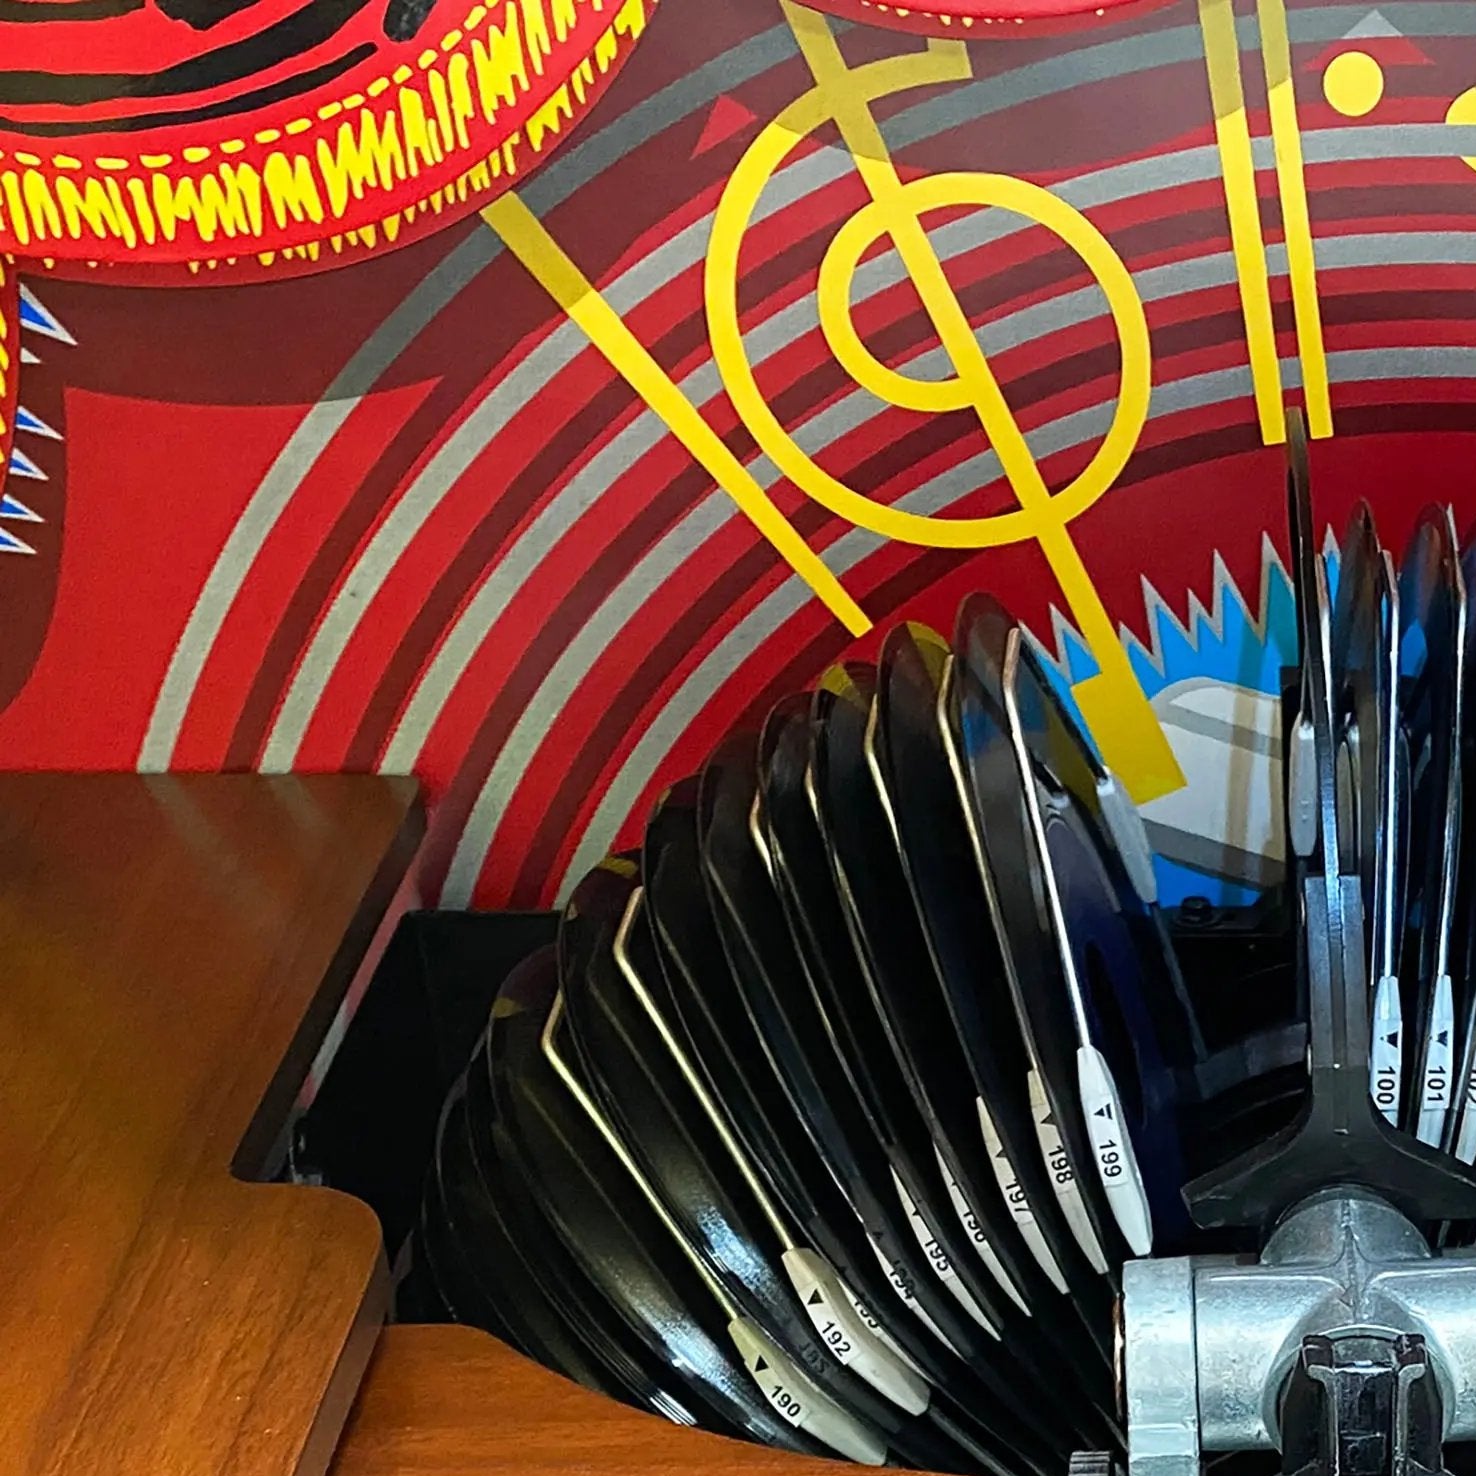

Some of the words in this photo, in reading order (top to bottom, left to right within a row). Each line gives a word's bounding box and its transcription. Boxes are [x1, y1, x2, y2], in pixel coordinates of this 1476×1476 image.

[1376, 1066, 1397, 1104] 100
[1427, 1065, 1447, 1101] 101
[1048, 1145, 1075, 1184] 198
[1099, 1138, 1123, 1178] 199
[1005, 1178, 1033, 1214] 197
[924, 1238, 950, 1273] 195
[821, 1320, 852, 1357] 192
[770, 1384, 802, 1418] 190
